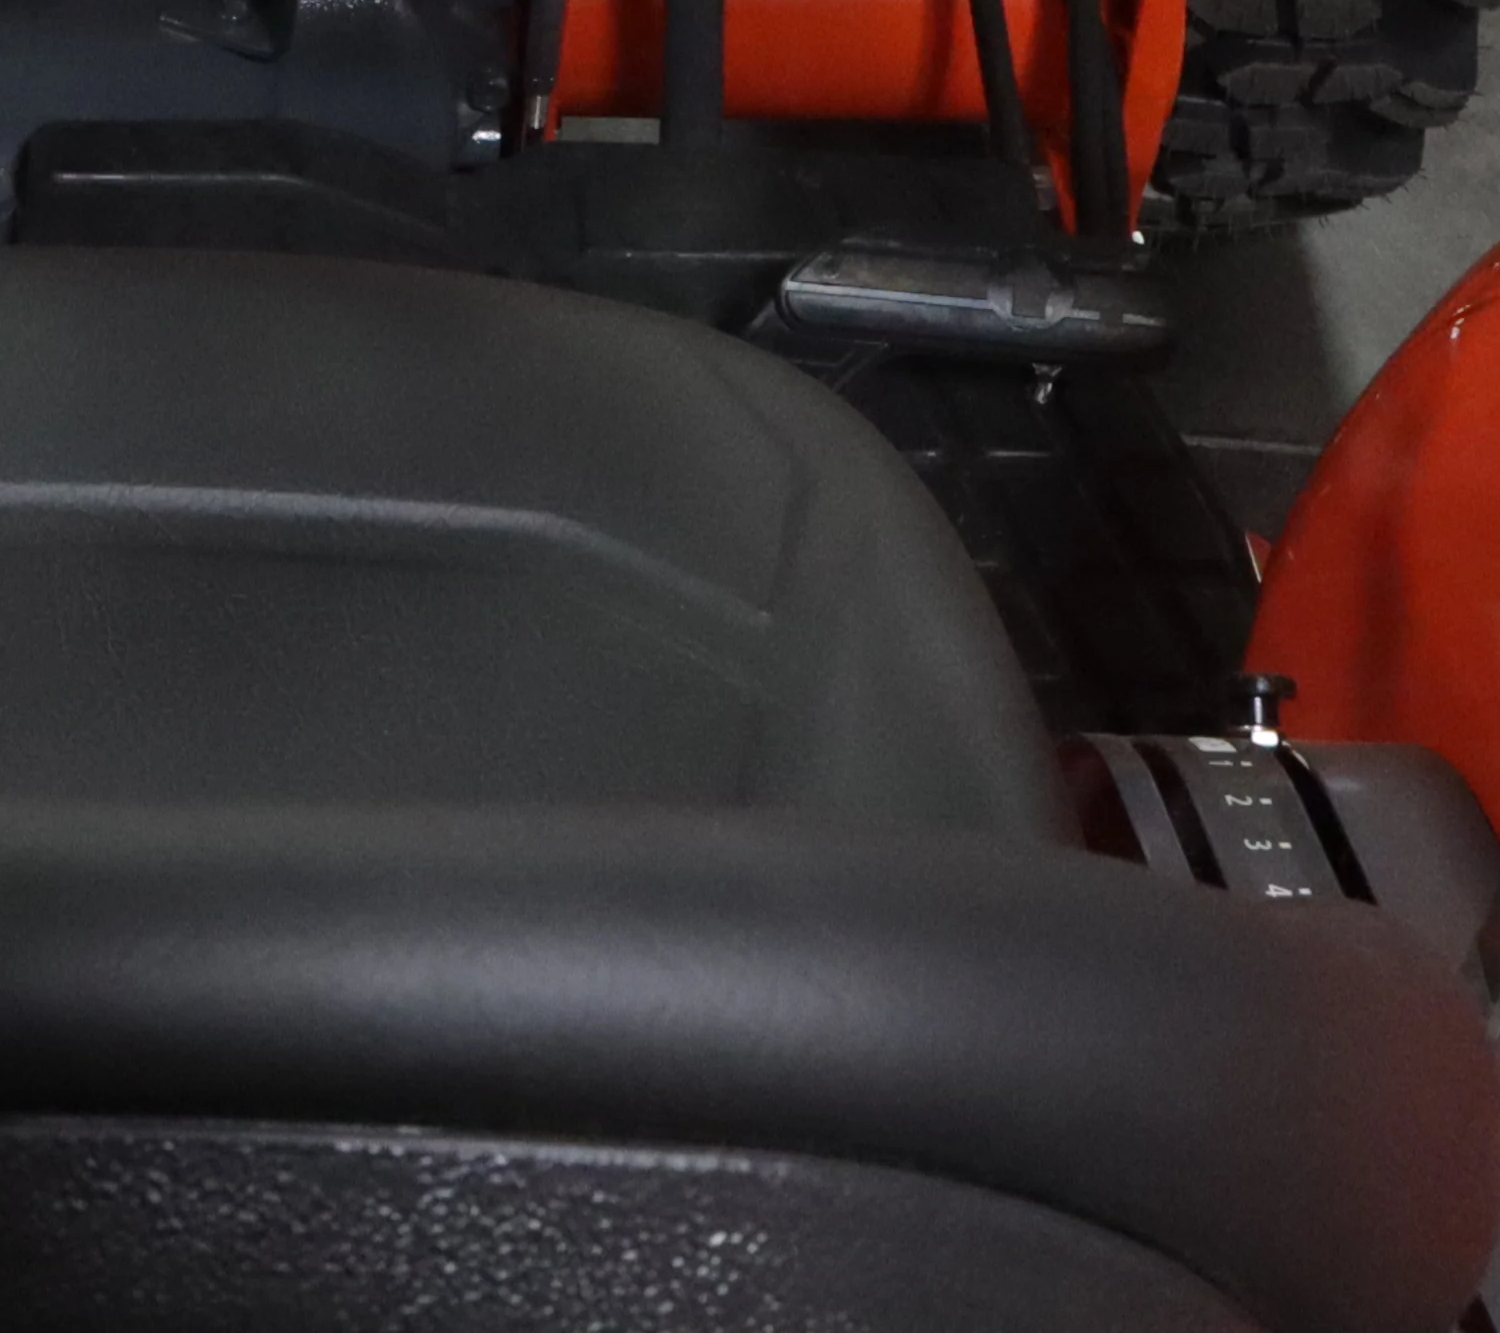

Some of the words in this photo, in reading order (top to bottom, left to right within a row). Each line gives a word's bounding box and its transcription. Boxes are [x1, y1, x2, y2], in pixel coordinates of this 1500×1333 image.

[1224, 794, 1253, 806] 2
[1243, 838, 1272, 850] 3
[1265, 883, 1293, 898] 4
